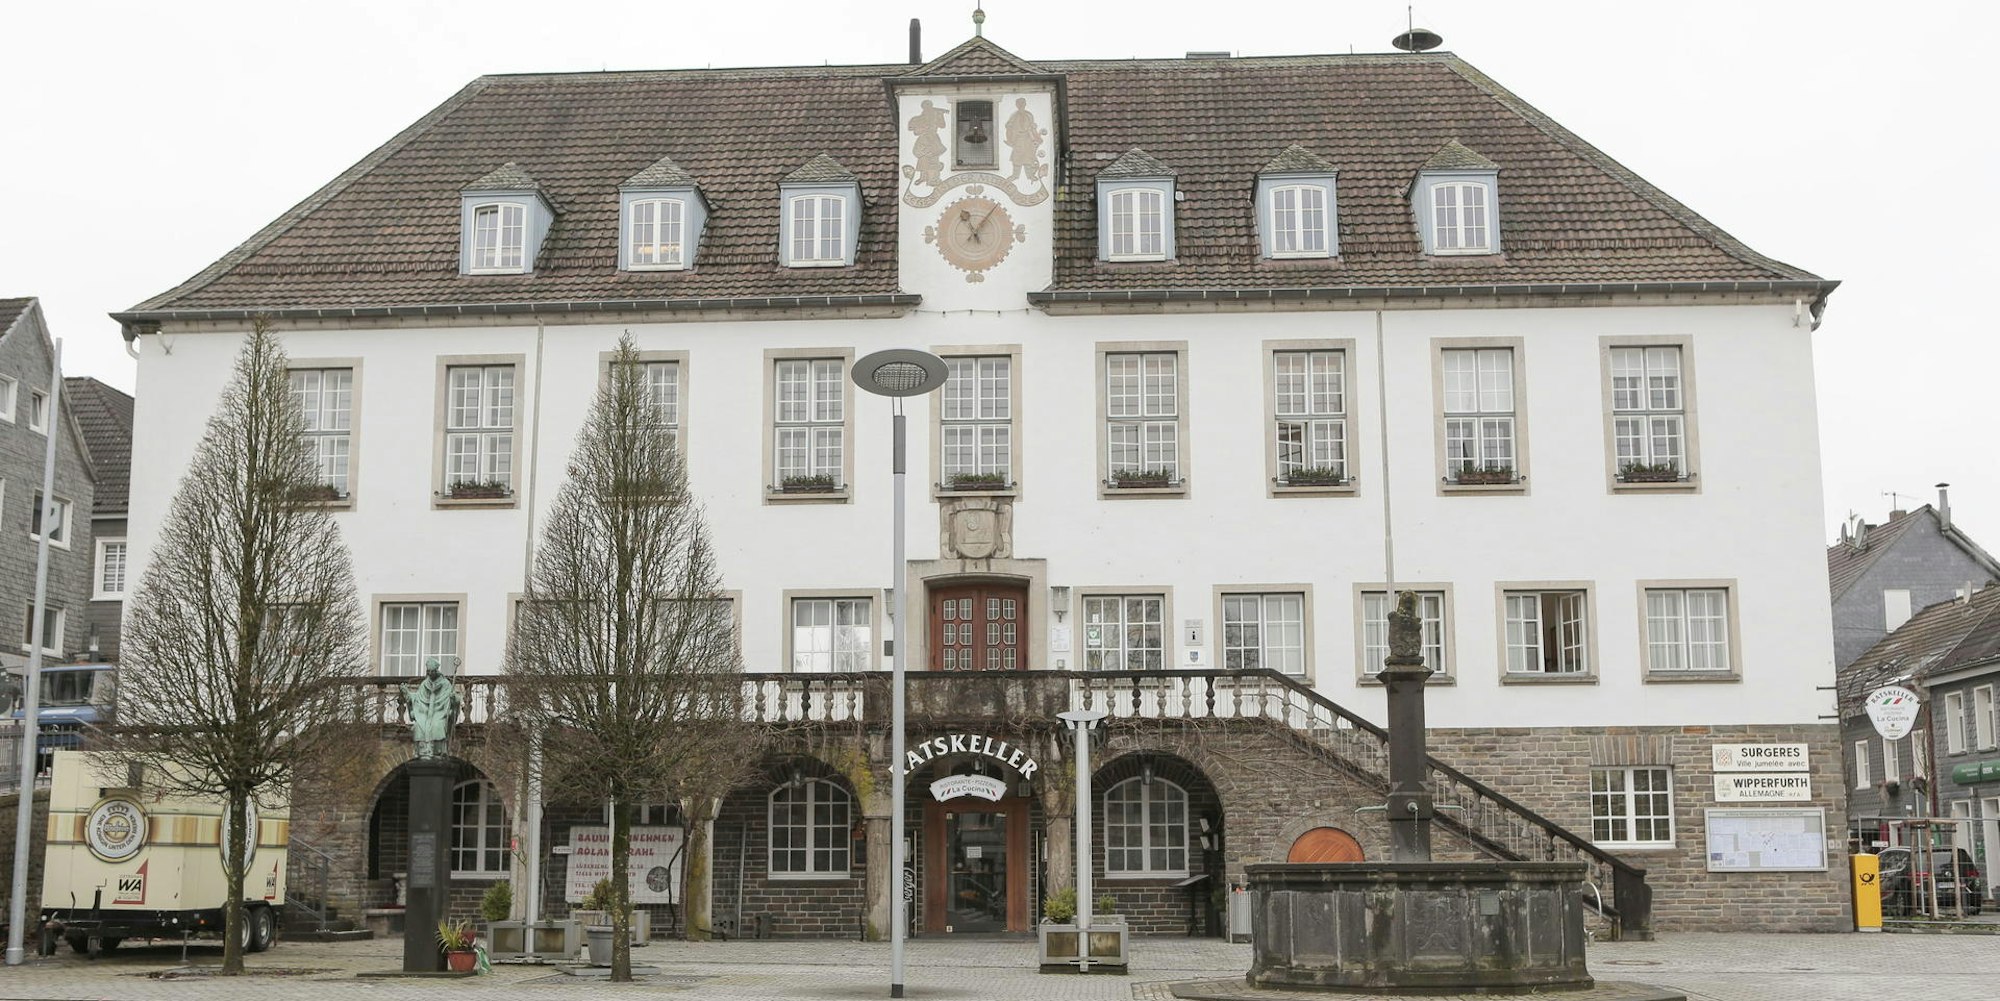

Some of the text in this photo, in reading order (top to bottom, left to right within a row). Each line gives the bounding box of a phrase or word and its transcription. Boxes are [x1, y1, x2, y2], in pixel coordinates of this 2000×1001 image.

[1870, 690, 1914, 704] RATSKELLER
[1741, 747, 1800, 757] SURGERES
[1755, 760, 1784, 768] jumelée
[1733, 777, 1808, 788] WIPPERFURTH
[961, 785, 985, 793] Cucina
[577, 847, 614, 857] ROLAN
[118, 878, 142, 892] WA
